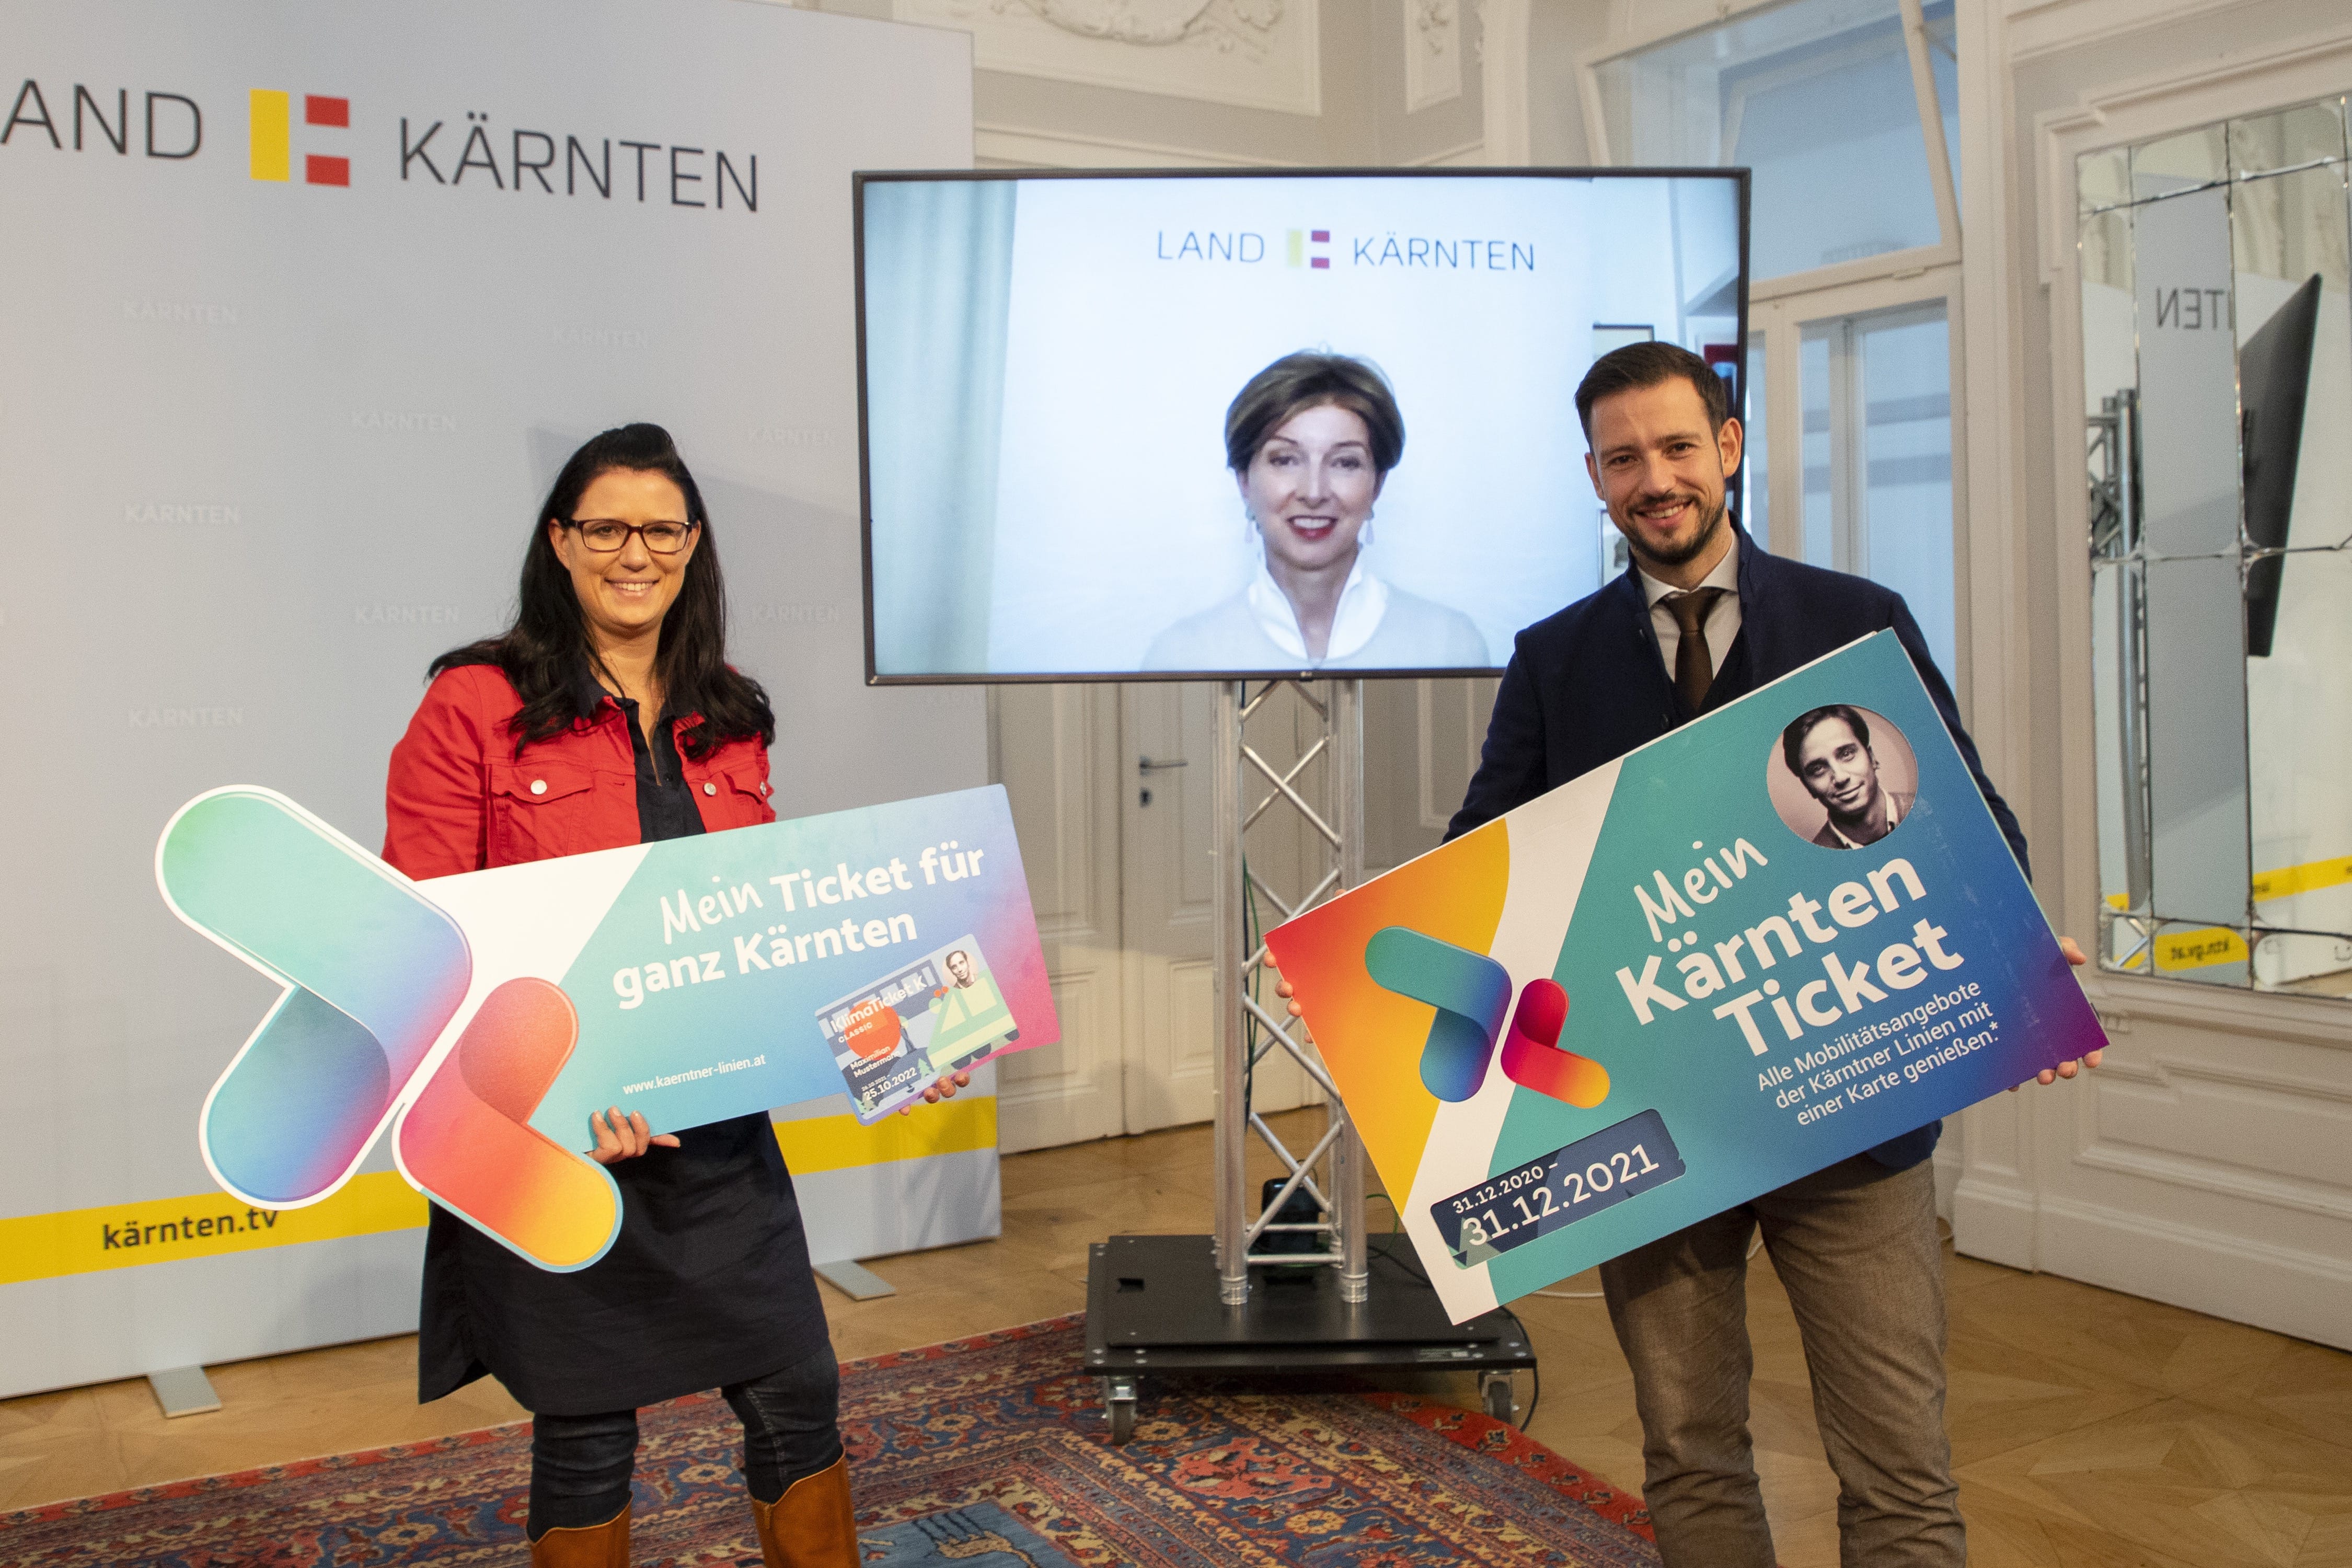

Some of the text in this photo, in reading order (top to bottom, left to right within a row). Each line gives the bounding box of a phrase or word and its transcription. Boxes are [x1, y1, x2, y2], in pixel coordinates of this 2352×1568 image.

[0, 78, 758, 212] AND KÄRNTEN
[1158, 230, 1534, 271] LAND KÄRNTEN
[660, 840, 985, 945] Mein Ticket für
[1633, 837, 1768, 943] Mein
[613, 912, 918, 1010] ganz Kärnten
[1615, 857, 1927, 1025] Kärnten
[831, 984, 914, 1033] KlimaTicket
[1712, 917, 1965, 1057] Ticket
[838, 1022, 873, 1043] CLASSIC
[850, 1046, 891, 1070] Maximilian
[1757, 982, 1981, 1091] Alle Mobilitätsangebote
[1775, 1001, 1993, 1109] der Kärntner Linien mit
[622, 1054, 766, 1094] www.kaerntner-linien.at
[864, 1067, 917, 1101] 25.10.2022
[1797, 1096, 1844, 1125] einer
[1846, 1070, 1901, 1104] Karte
[1452, 1165, 1544, 1214] 31.12.2020
[1462, 1144, 1659, 1246] 31.12.2021
[102, 1208, 280, 1250] kärnten.tv
